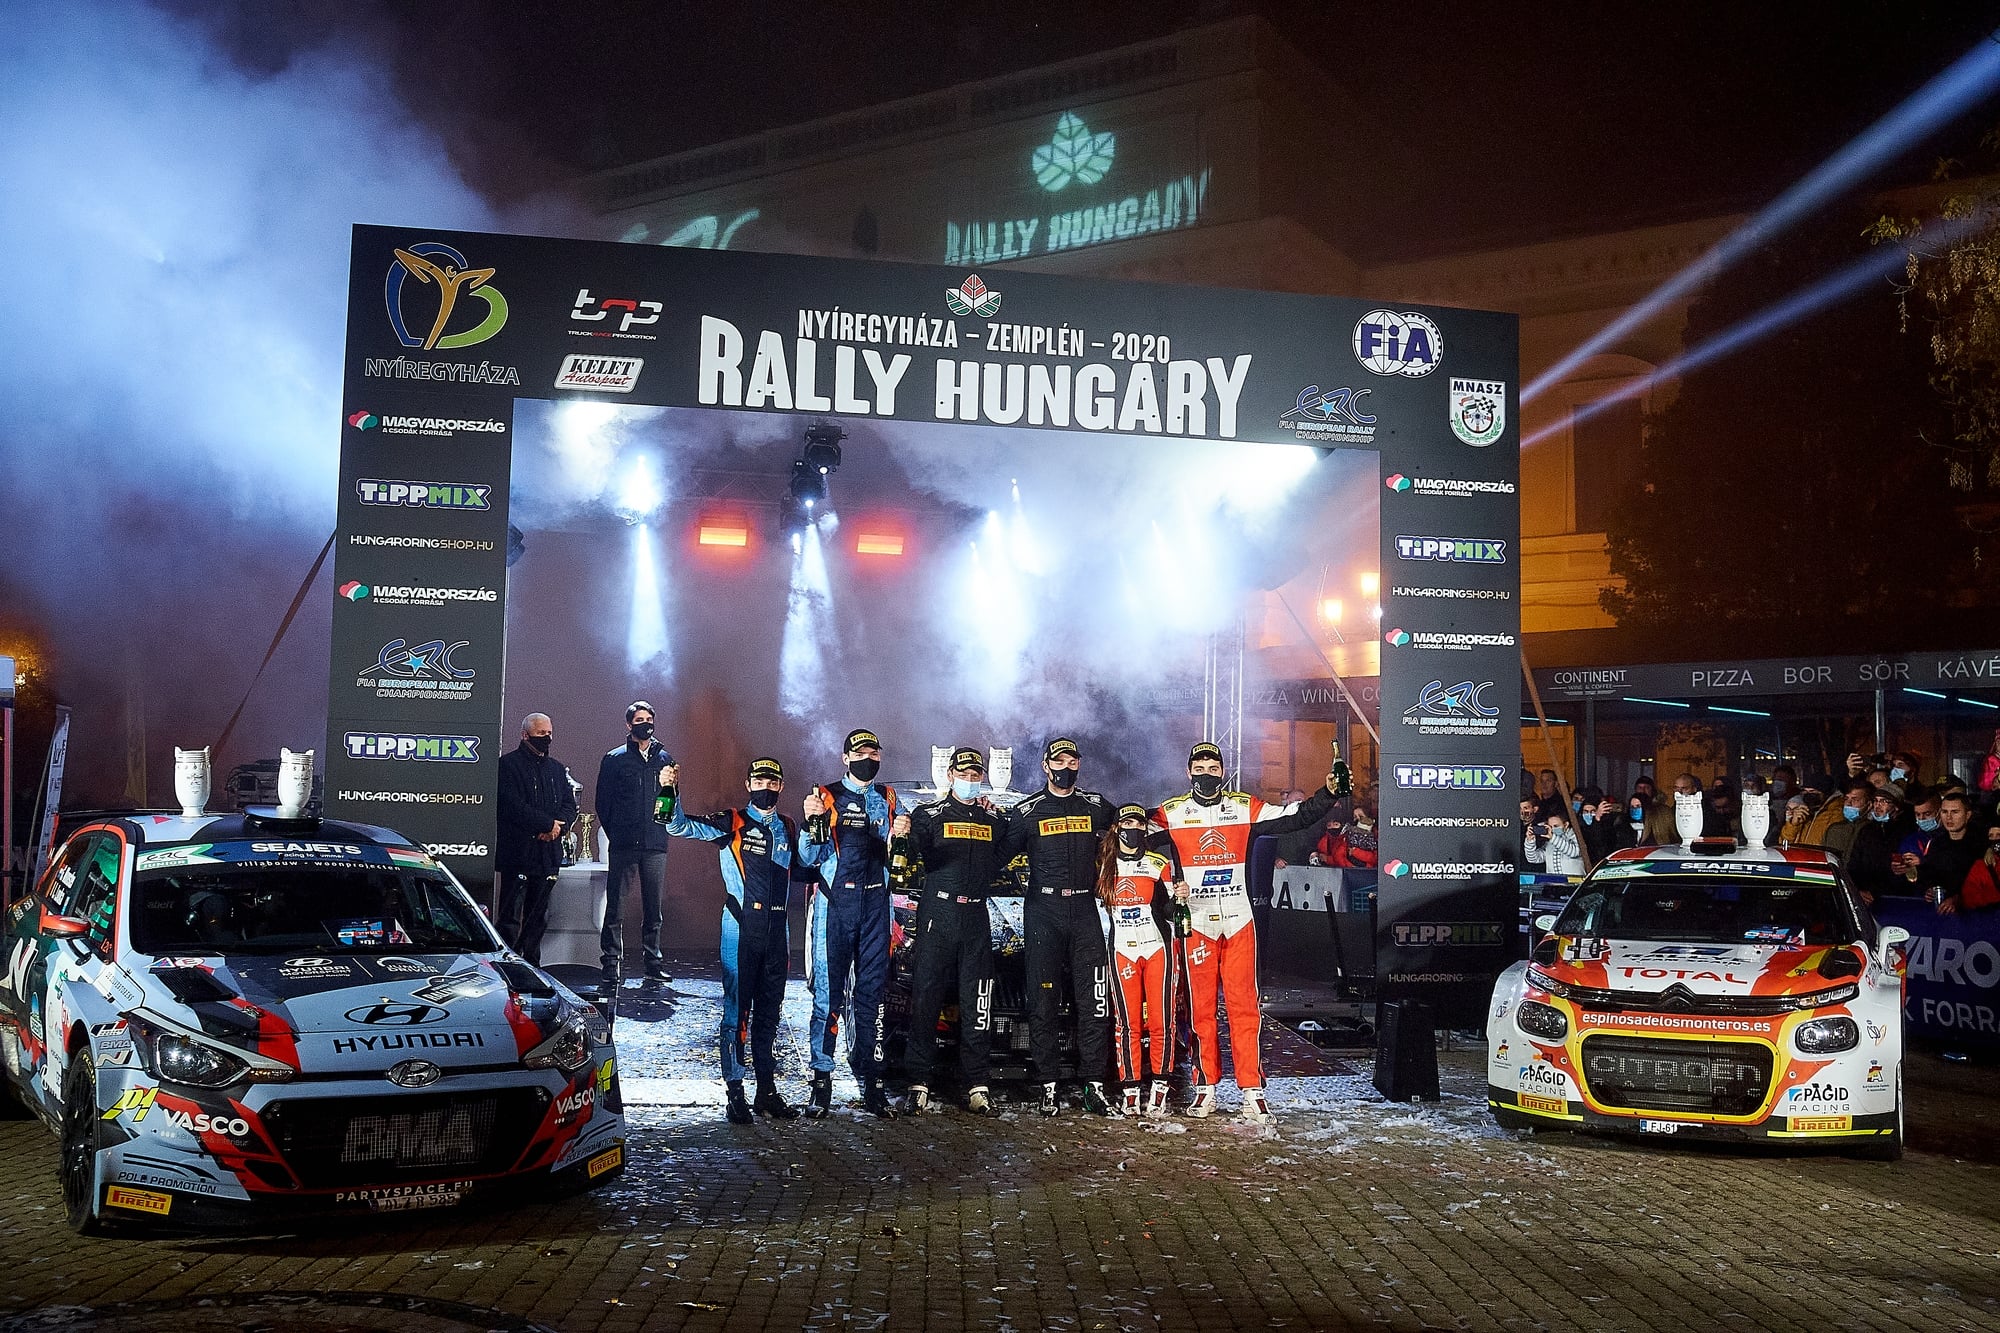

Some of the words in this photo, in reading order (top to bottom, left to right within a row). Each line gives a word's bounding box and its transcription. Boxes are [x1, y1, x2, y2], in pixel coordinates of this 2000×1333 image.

[798, 305, 958, 349] NYÍREGYHÁZA
[986, 322, 1084, 357] ZEMPLÉN
[1111, 332, 1171, 363] 2020
[364, 355, 520, 385] NYÍREGYHÁZA
[569, 357, 635, 376] KELET
[562, 372, 633, 387] Autosport
[698, 314, 912, 416] RALLY
[935, 353, 1252, 438] HUNGARY
[1453, 380, 1502, 395] MNASZ
[382, 414, 506, 433] MAGYARORSZÁG
[389, 427, 417, 435] CSODÁK
[1278, 421, 1295, 430] FIA
[1296, 421, 1346, 433] EUROPEAN
[1347, 425, 1376, 434] RALLY
[1295, 431, 1375, 443] CHAMPIONSHIP
[1413, 478, 1514, 493] MAGYARORSZÁG
[350, 535, 494, 551] HUNGARORINGSHOP.HU
[373, 585, 498, 602] MAGYARORSZÁG
[1392, 586, 1510, 600] HUNGARORINGSHOP.HU
[380, 597, 410, 605] CSODÁK
[410, 598, 444, 606] FORRÁSA
[1413, 632, 1514, 646] MAGYARORSZÁG
[1784, 665, 1832, 684] BOR
[1859, 659, 1910, 681] SÖR
[1938, 655, 2000, 679] KÁVÉ
[357, 677, 376, 687] FIA
[378, 678, 438, 689] EUROPEAN
[439, 680, 473, 691] RALLY
[1554, 669, 1627, 684] CONTINENT
[1692, 669, 1754, 688] PIZZA
[376, 688, 472, 700] CHAMPIONSHIP
[1302, 687, 1346, 703] WINE
[1420, 717, 1469, 726] EUROPEAN
[1470, 718, 1499, 726] RALLY
[1419, 726, 1497, 735] CHAMPIONSHIP
[338, 790, 483, 804] HUNGARORINGSHOP.HU
[1043, 818, 1089, 833] PIRELLI
[1391, 817, 1509, 827] HUNGARORINGSHOP.HU
[947, 824, 990, 838] PIRELLI
[251, 843, 362, 855] SEAJETS
[236, 860, 298, 868] villabouw
[314, 861, 401, 871] woonprojecten
[1412, 861, 1514, 874] MAGYARORSZÁG
[1680, 863, 1770, 872] SEAJETS
[1191, 885, 1242, 894] RALLYE
[1616, 967, 1748, 984] TOTAL
[1094, 966, 1107, 1017] WRC
[974, 979, 991, 1030] WRC
[1582, 1012, 1771, 1032] espinosadelosmonteros.es
[1922, 998, 2000, 1034] FORR
[100, 1040, 132, 1049] BMA
[333, 1032, 484, 1054] HYUNDAI
[1528, 1065, 1566, 1085] PAGID
[1590, 1055, 1761, 1082] CITROËN
[1519, 1083, 1566, 1096] RACING
[1804, 1084, 1849, 1101] PAGID
[556, 1087, 595, 1115] VASCO
[1521, 1094, 1562, 1113] PIRELLI
[1789, 1103, 1850, 1112] RACING
[163, 1108, 249, 1136] VASCO
[1793, 1117, 1846, 1130] PIRELLI
[592, 1151, 618, 1174] PIRELLI
[118, 1171, 147, 1183] POLE
[151, 1176, 217, 1194] PROMOTION
[112, 1190, 167, 1210] PIRELLI
